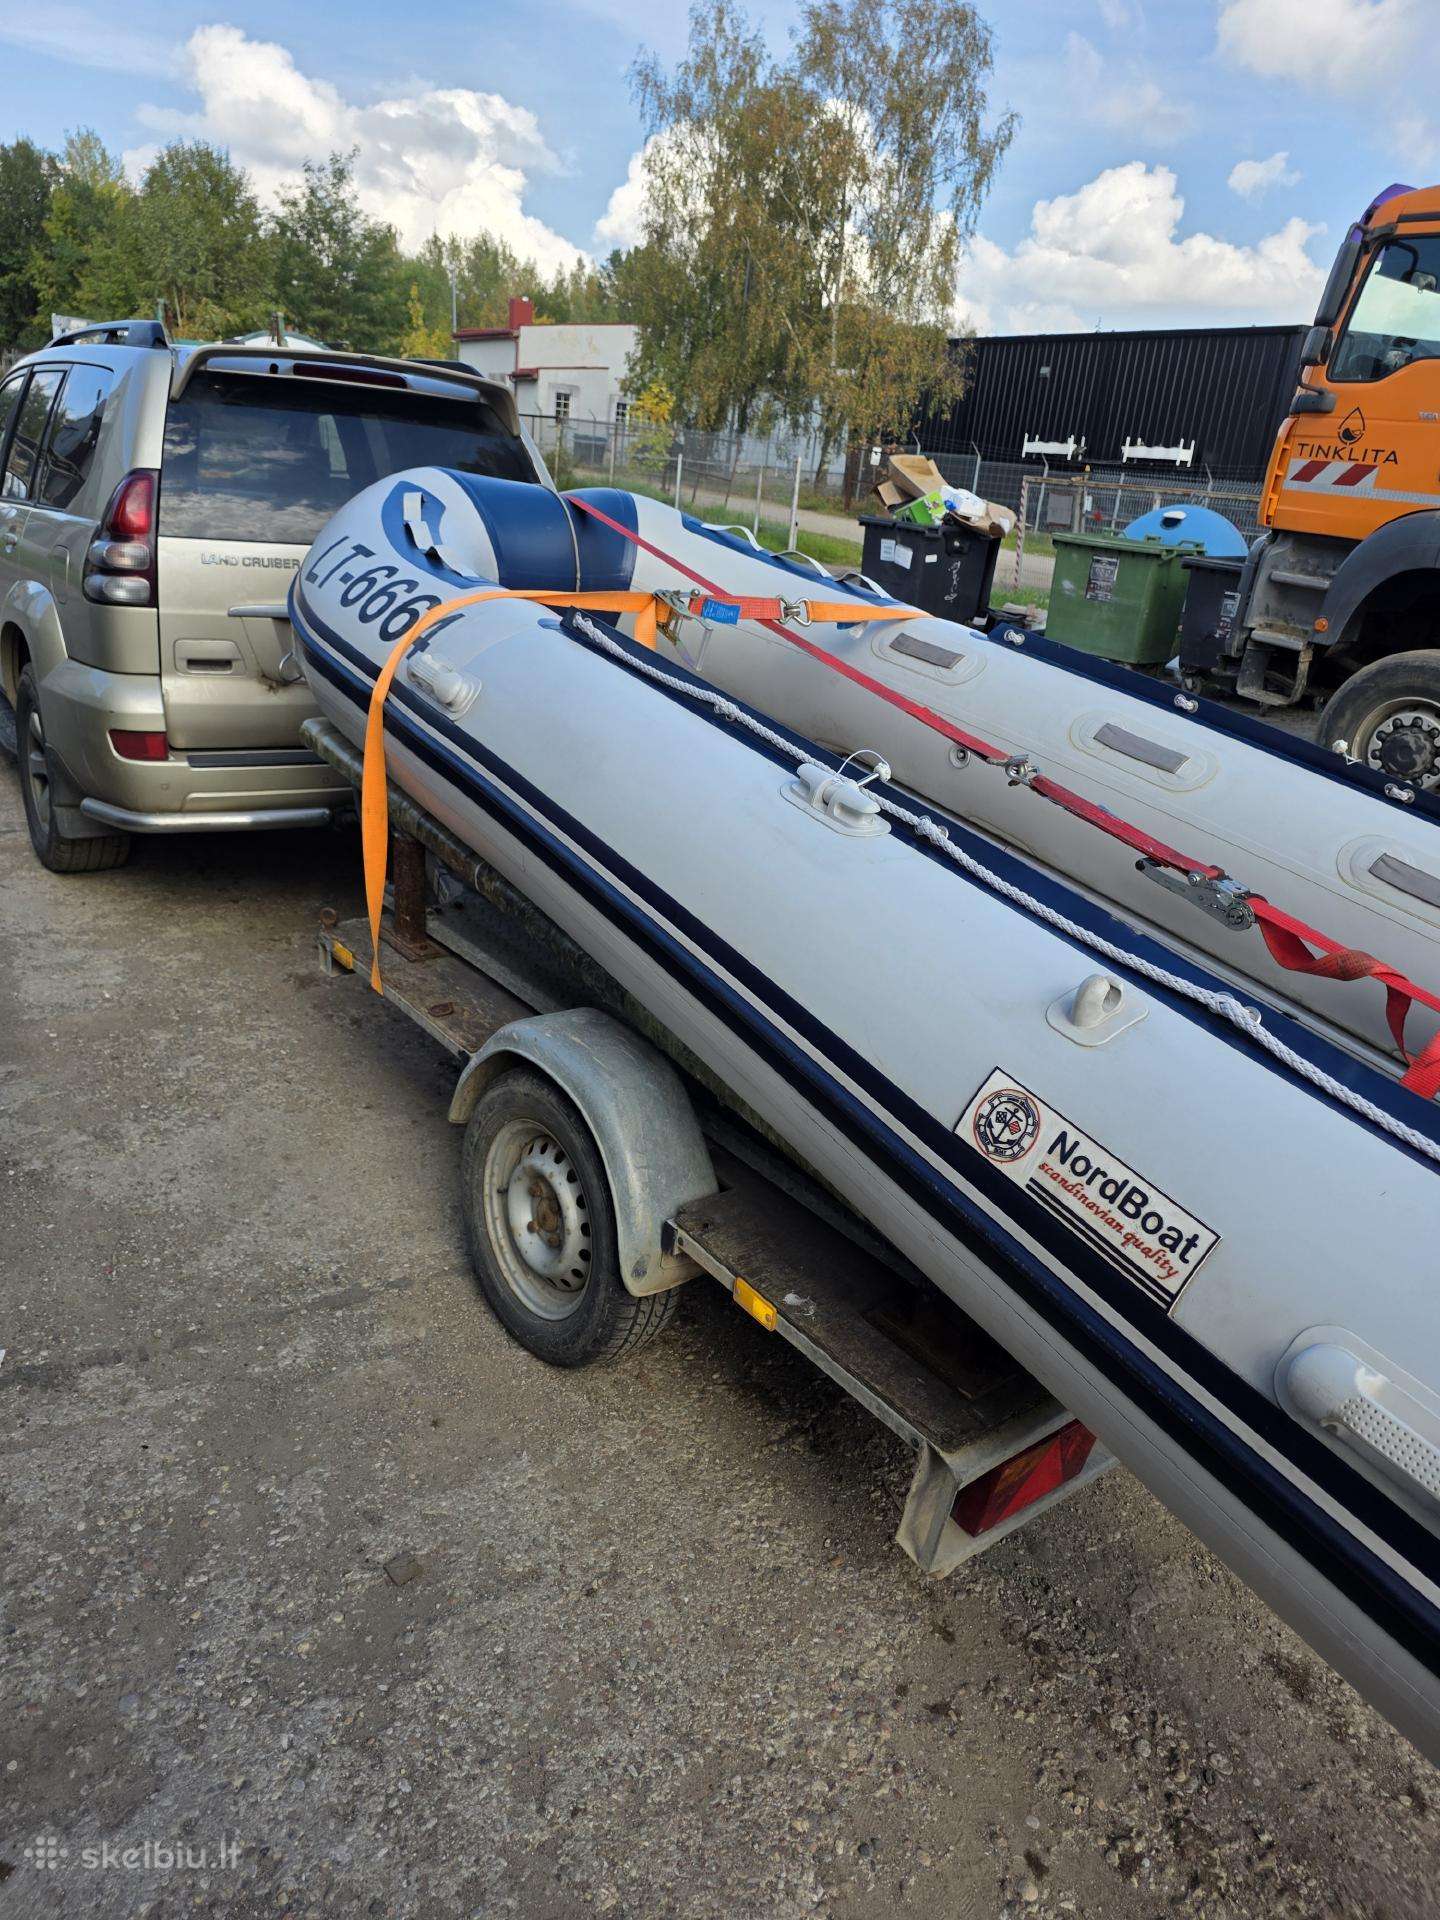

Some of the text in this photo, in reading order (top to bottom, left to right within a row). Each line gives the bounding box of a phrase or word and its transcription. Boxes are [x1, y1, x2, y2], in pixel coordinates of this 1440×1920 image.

[1297, 442, 1399, 465] TINKLITA
[201, 552, 301, 570] LAND CRUISER
[1038, 1161, 1180, 1281] scandinavian quality
[1046, 1130, 1200, 1265] NordBoat
